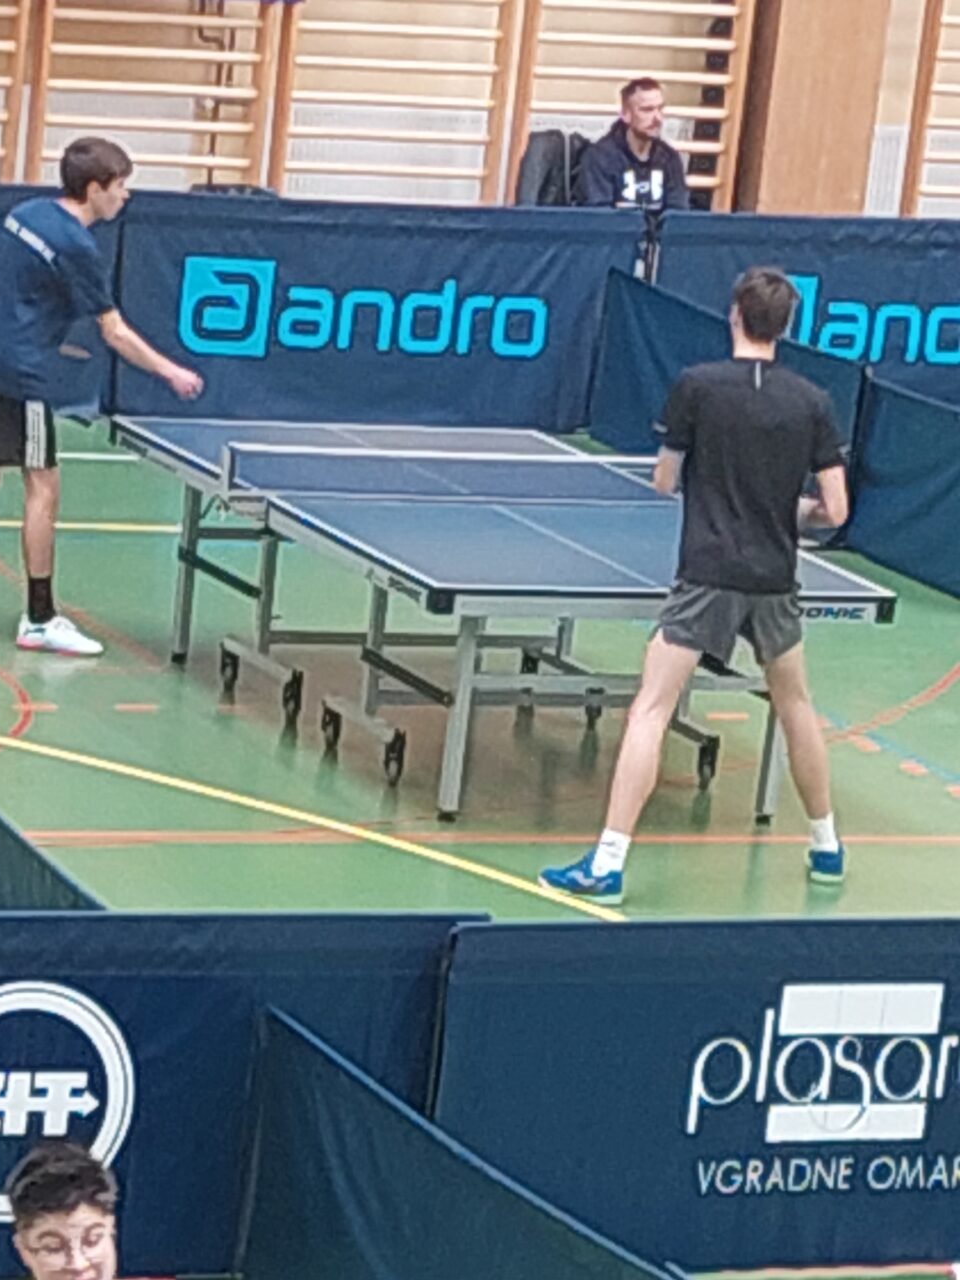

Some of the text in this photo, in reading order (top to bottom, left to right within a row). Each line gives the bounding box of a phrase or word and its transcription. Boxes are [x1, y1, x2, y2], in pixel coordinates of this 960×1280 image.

[278, 278, 548, 358] andro
[797, 606, 867, 620] ONIC
[697, 1156, 854, 1195] VGRADNE
